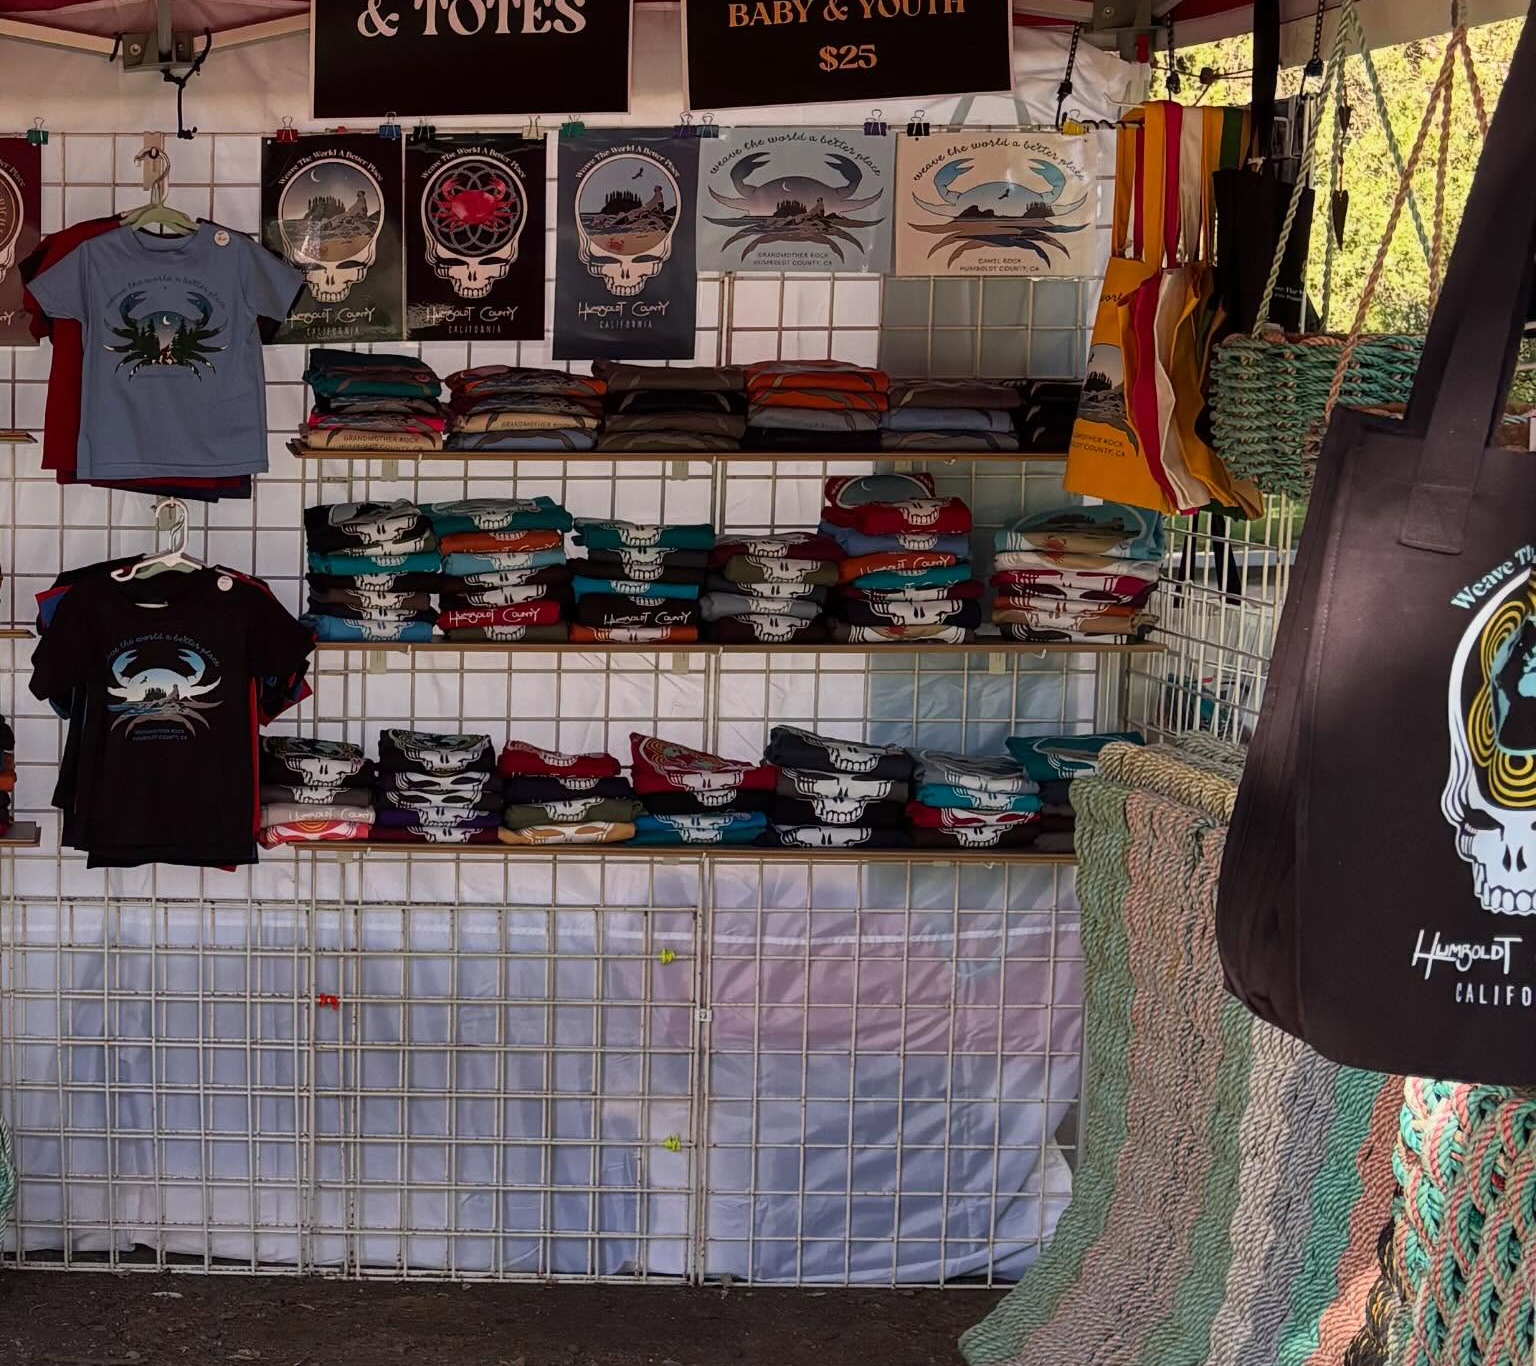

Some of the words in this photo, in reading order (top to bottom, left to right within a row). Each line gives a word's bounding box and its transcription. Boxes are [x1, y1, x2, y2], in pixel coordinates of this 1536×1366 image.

[818, 44, 878, 72] $25
[312, 149, 337, 158] World
[456, 146, 481, 155] World
[710, 148, 742, 175] weave
[744, 139, 765, 150] the
[768, 132, 807, 144] world
[820, 136, 856, 155] better
[855, 153, 881, 177] place
[913, 154, 945, 181] weave
[947, 145, 968, 157] the
[971, 138, 1009, 149] world
[1023, 141, 1058, 160] better
[1450, 561, 1515, 609] Weave
[1411, 929, 1523, 980] HUMBOLDT
